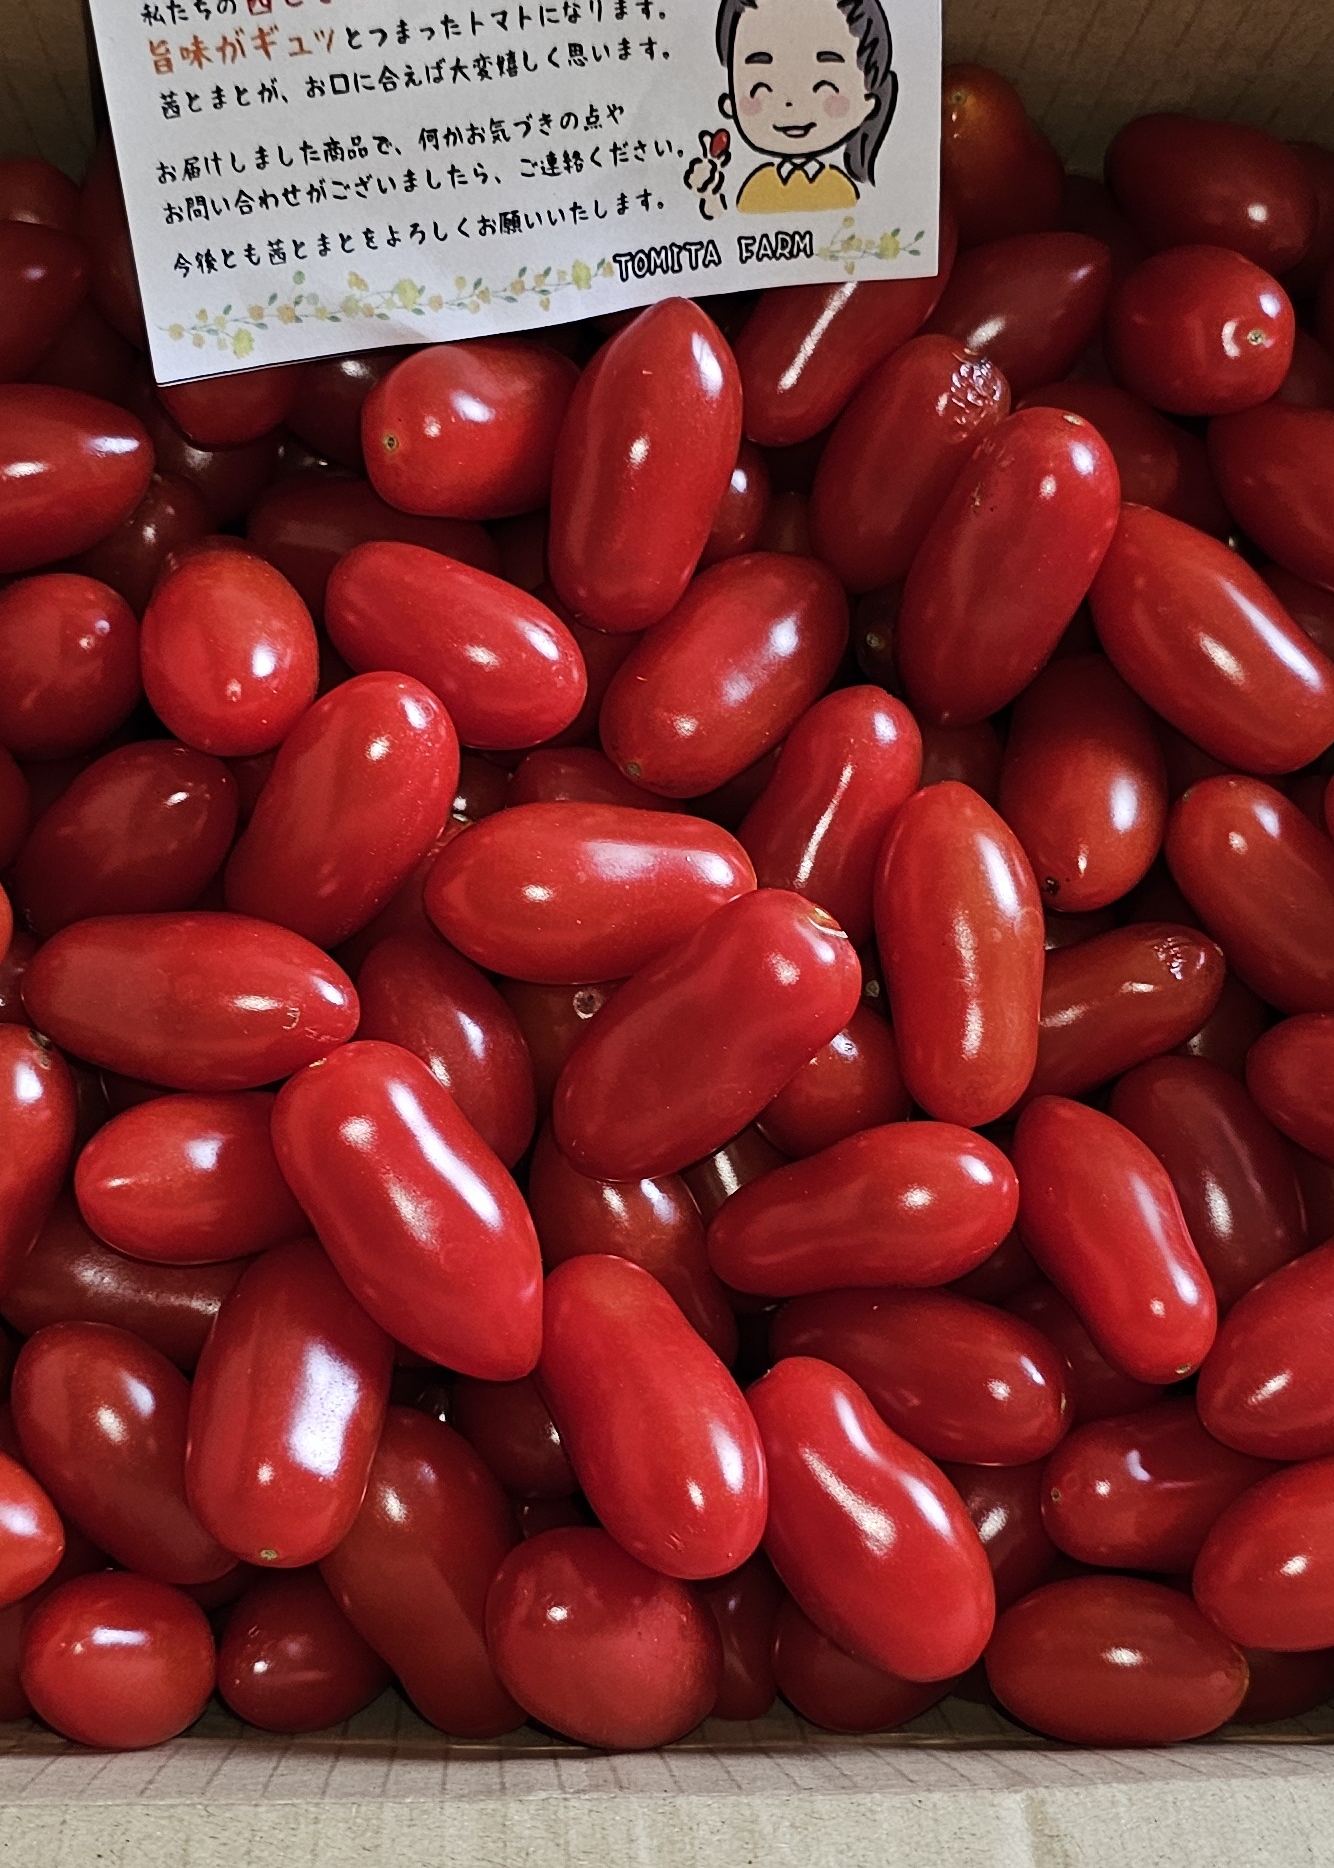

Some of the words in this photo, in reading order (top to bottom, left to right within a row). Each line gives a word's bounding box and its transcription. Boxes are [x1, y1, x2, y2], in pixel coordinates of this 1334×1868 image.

[156, 103, 624, 185] お届けしました商品で、何かお気づきの点や
[173, 188, 665, 278] 今後とも茜とまとをよろしくお願いいたします。
[613, 239, 722, 282] TOMITA
[737, 230, 814, 264] FARM
